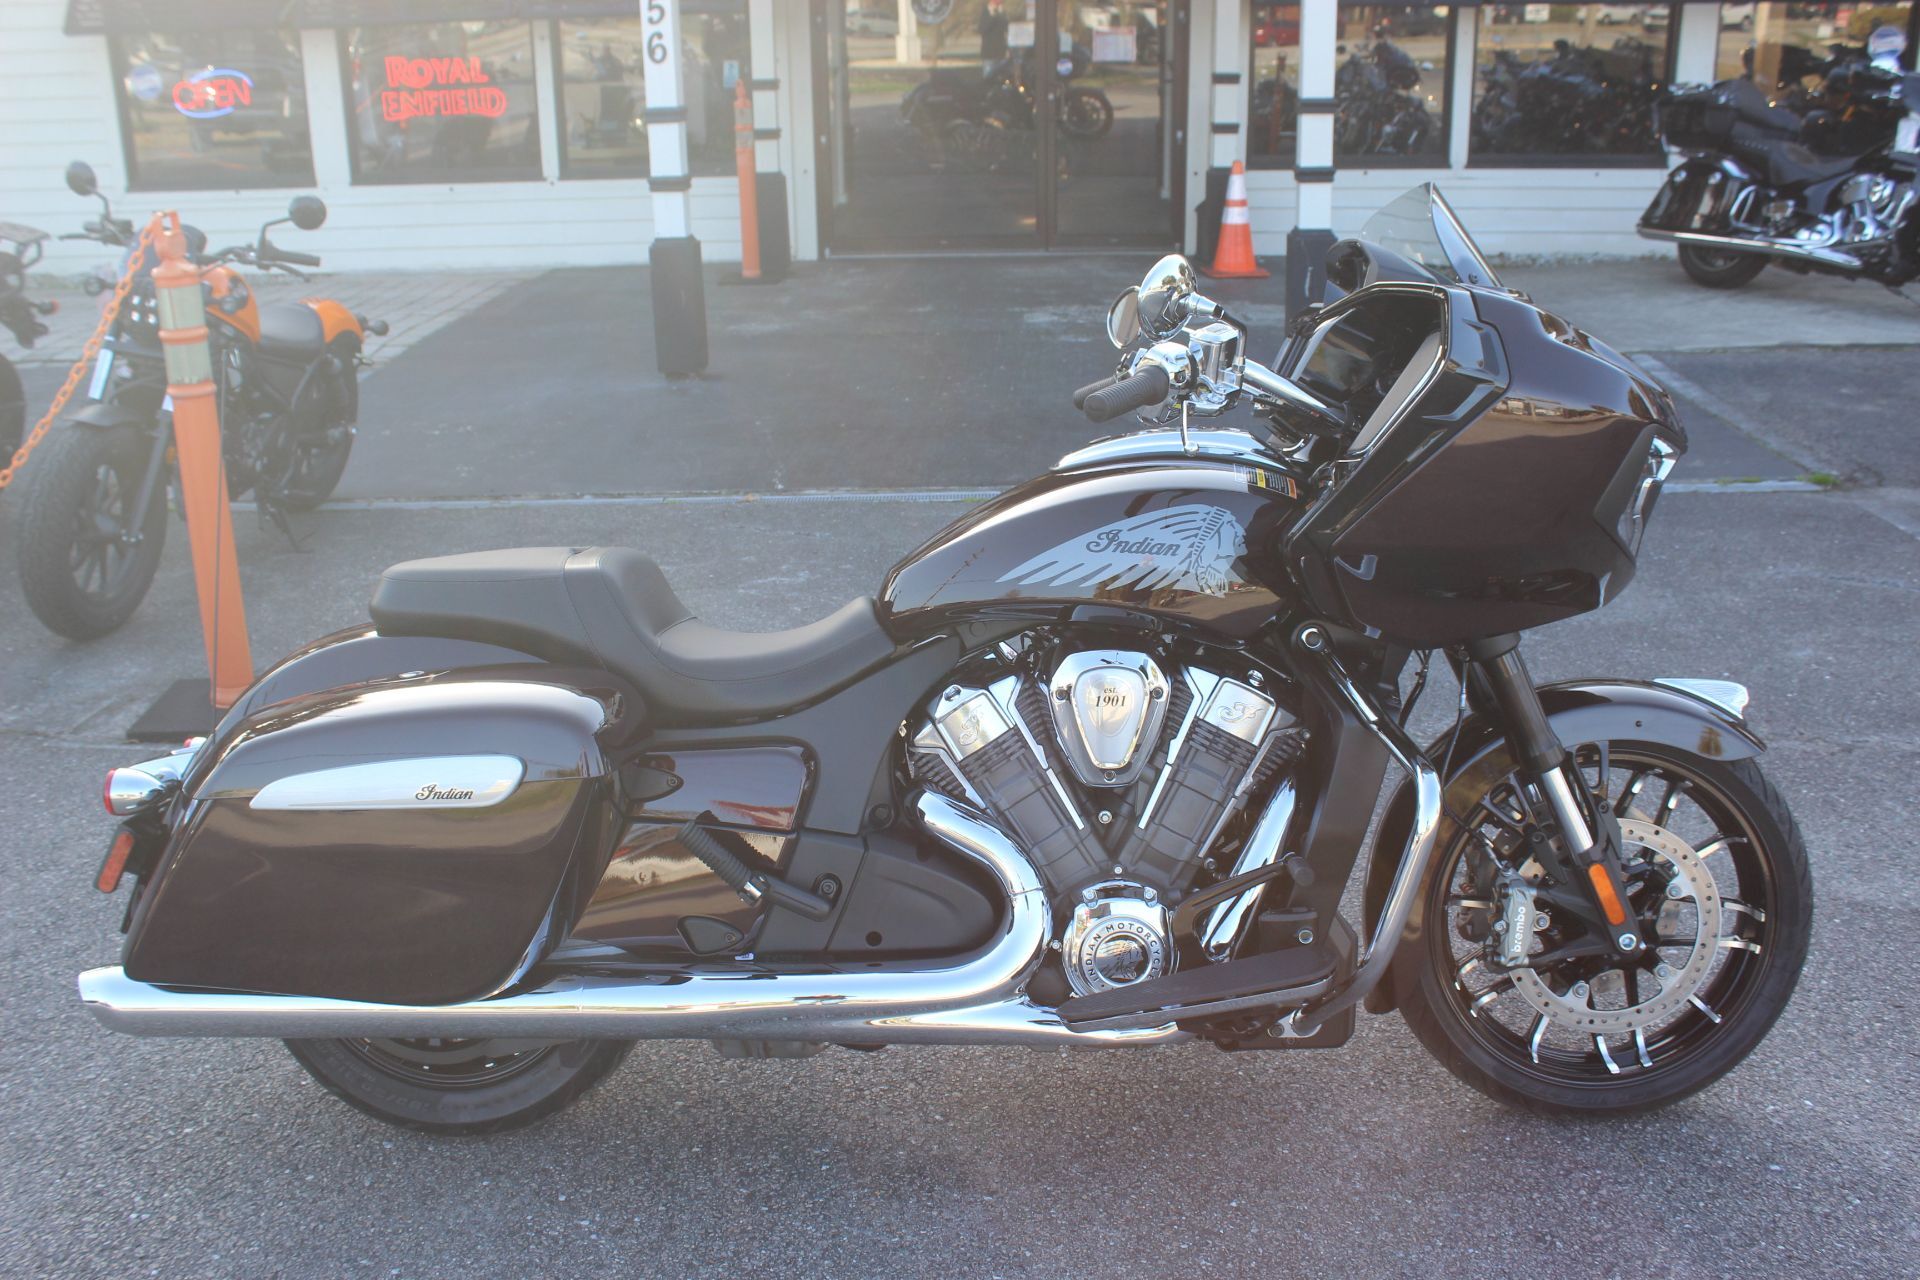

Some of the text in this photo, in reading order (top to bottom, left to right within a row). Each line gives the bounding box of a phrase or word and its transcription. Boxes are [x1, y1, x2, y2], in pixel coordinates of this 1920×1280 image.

[383, 55, 490, 89] ROYAL
[172, 78, 252, 110] OPEN
[381, 87, 507, 122] ENFIELD
[1085, 528, 1181, 557] Indian
[1095, 695, 1127, 707] 1901
[415, 783, 474, 801] Indian
[1510, 906, 1527, 953] brembo
[1085, 933, 1102, 983] INDIAN
